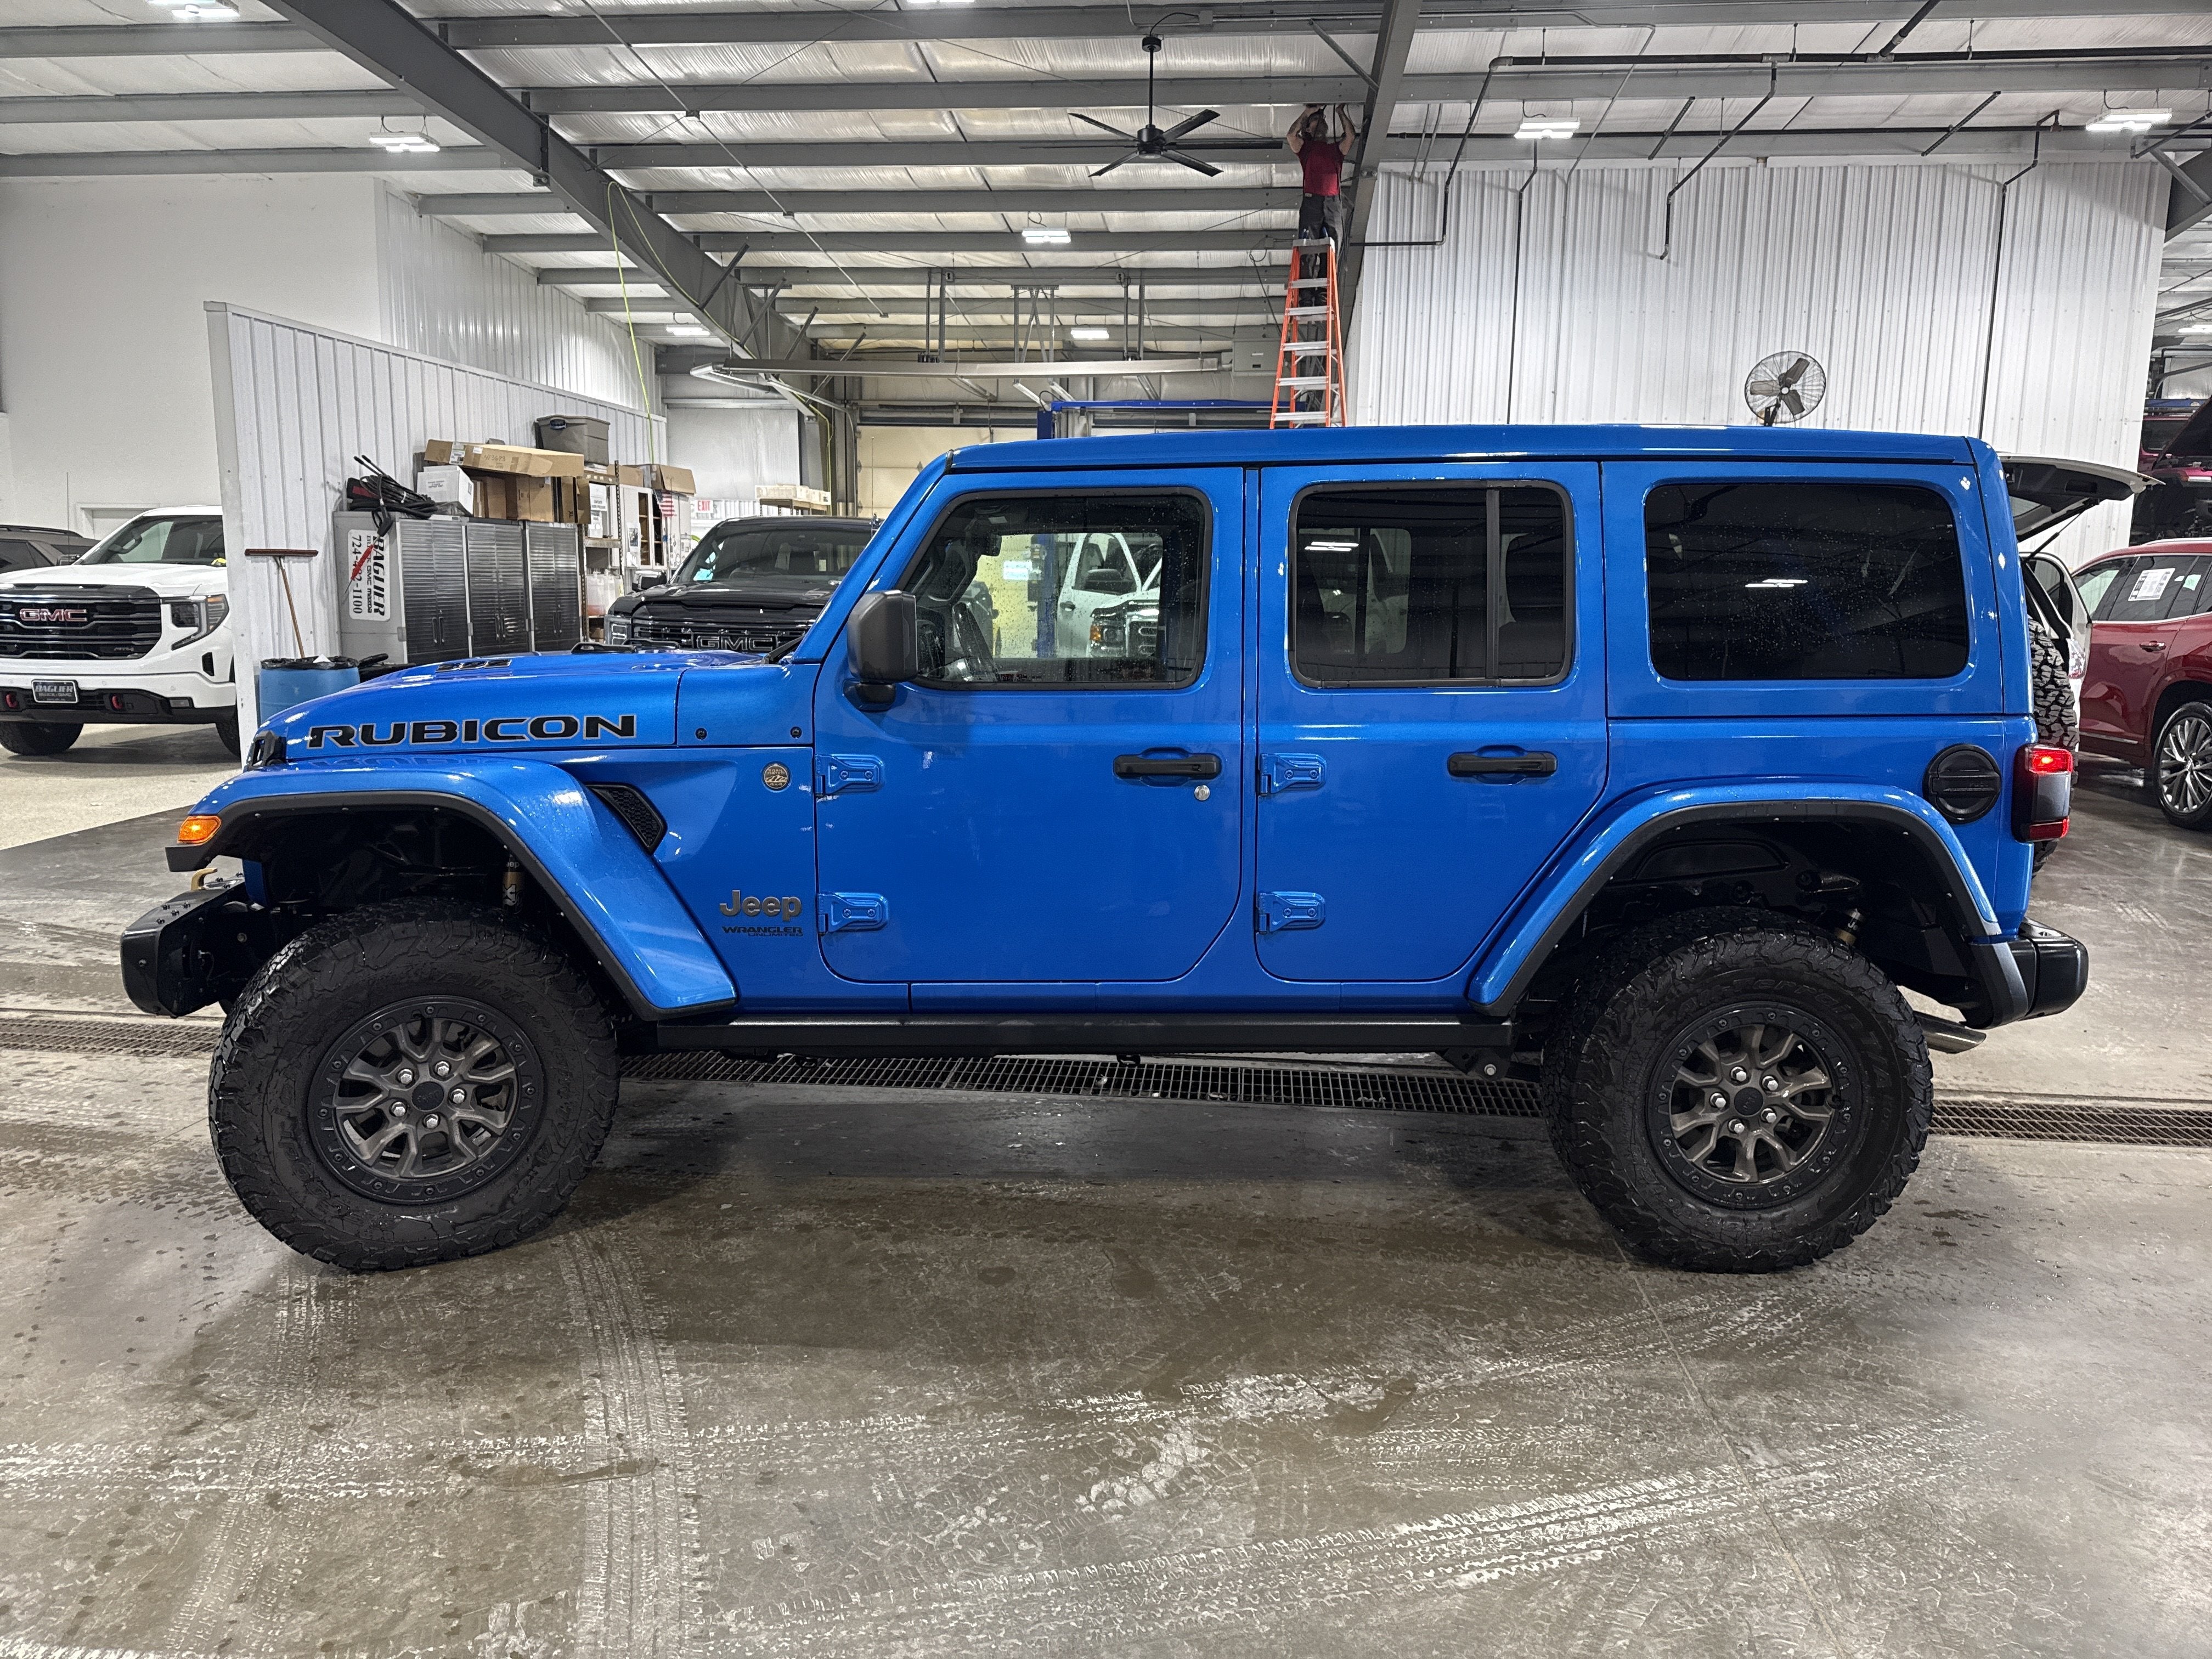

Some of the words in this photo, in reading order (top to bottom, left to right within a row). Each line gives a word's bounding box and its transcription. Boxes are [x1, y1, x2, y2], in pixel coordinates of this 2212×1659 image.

[697, 500, 710, 511] EXIT
[373, 535, 385, 616] BAGLIER
[20, 608, 87, 622] GMC
[696, 635, 772, 651] GMC
[307, 714, 637, 749] RUBICON
[719, 889, 802, 922] Jeep
